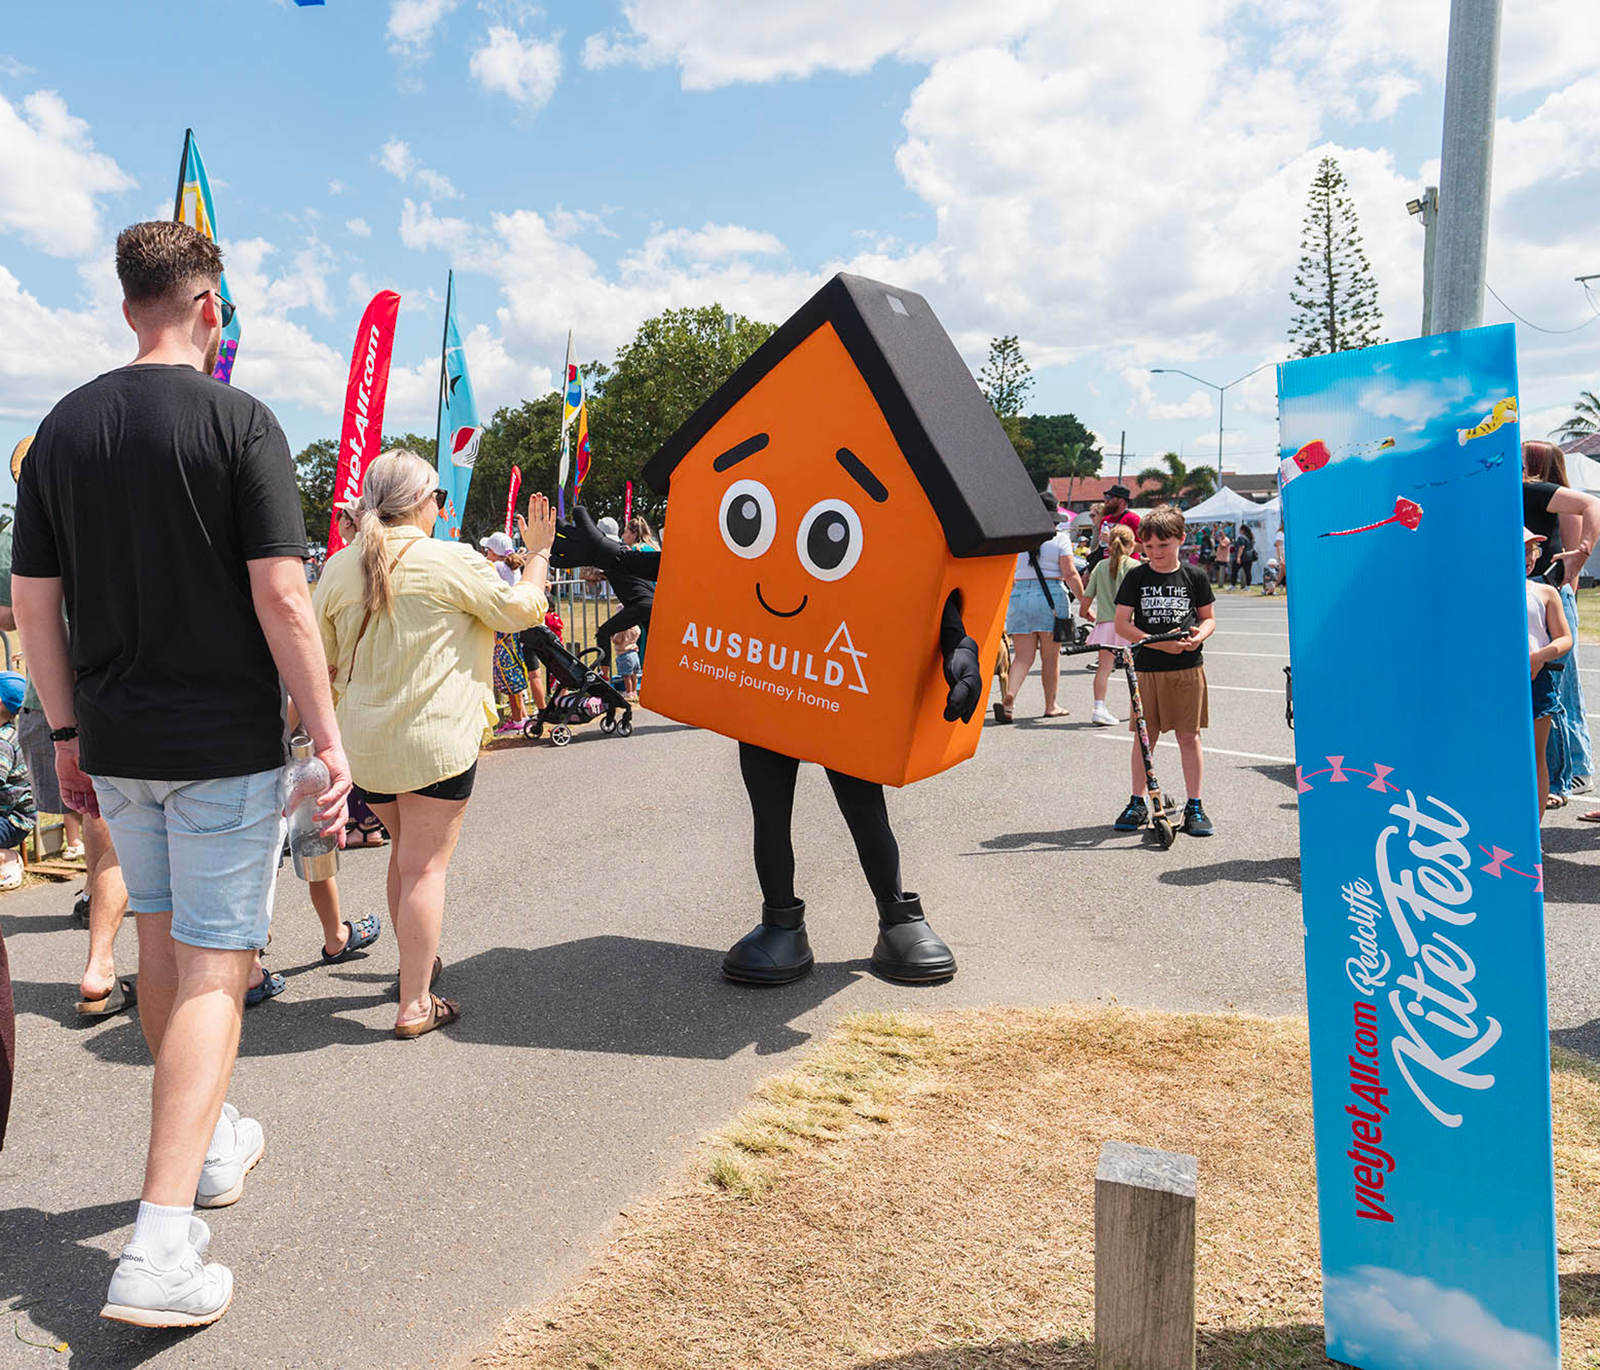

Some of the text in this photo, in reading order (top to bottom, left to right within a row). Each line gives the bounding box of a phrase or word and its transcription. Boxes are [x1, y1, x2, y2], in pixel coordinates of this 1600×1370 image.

[1140, 585, 1188, 598] I'M THE
[678, 654, 841, 713] A simple journey home
[681, 621, 845, 687] AUSBUILD
[1341, 877, 1391, 996] Redcliffe
[1375, 789, 1502, 1128] Kite Fest
